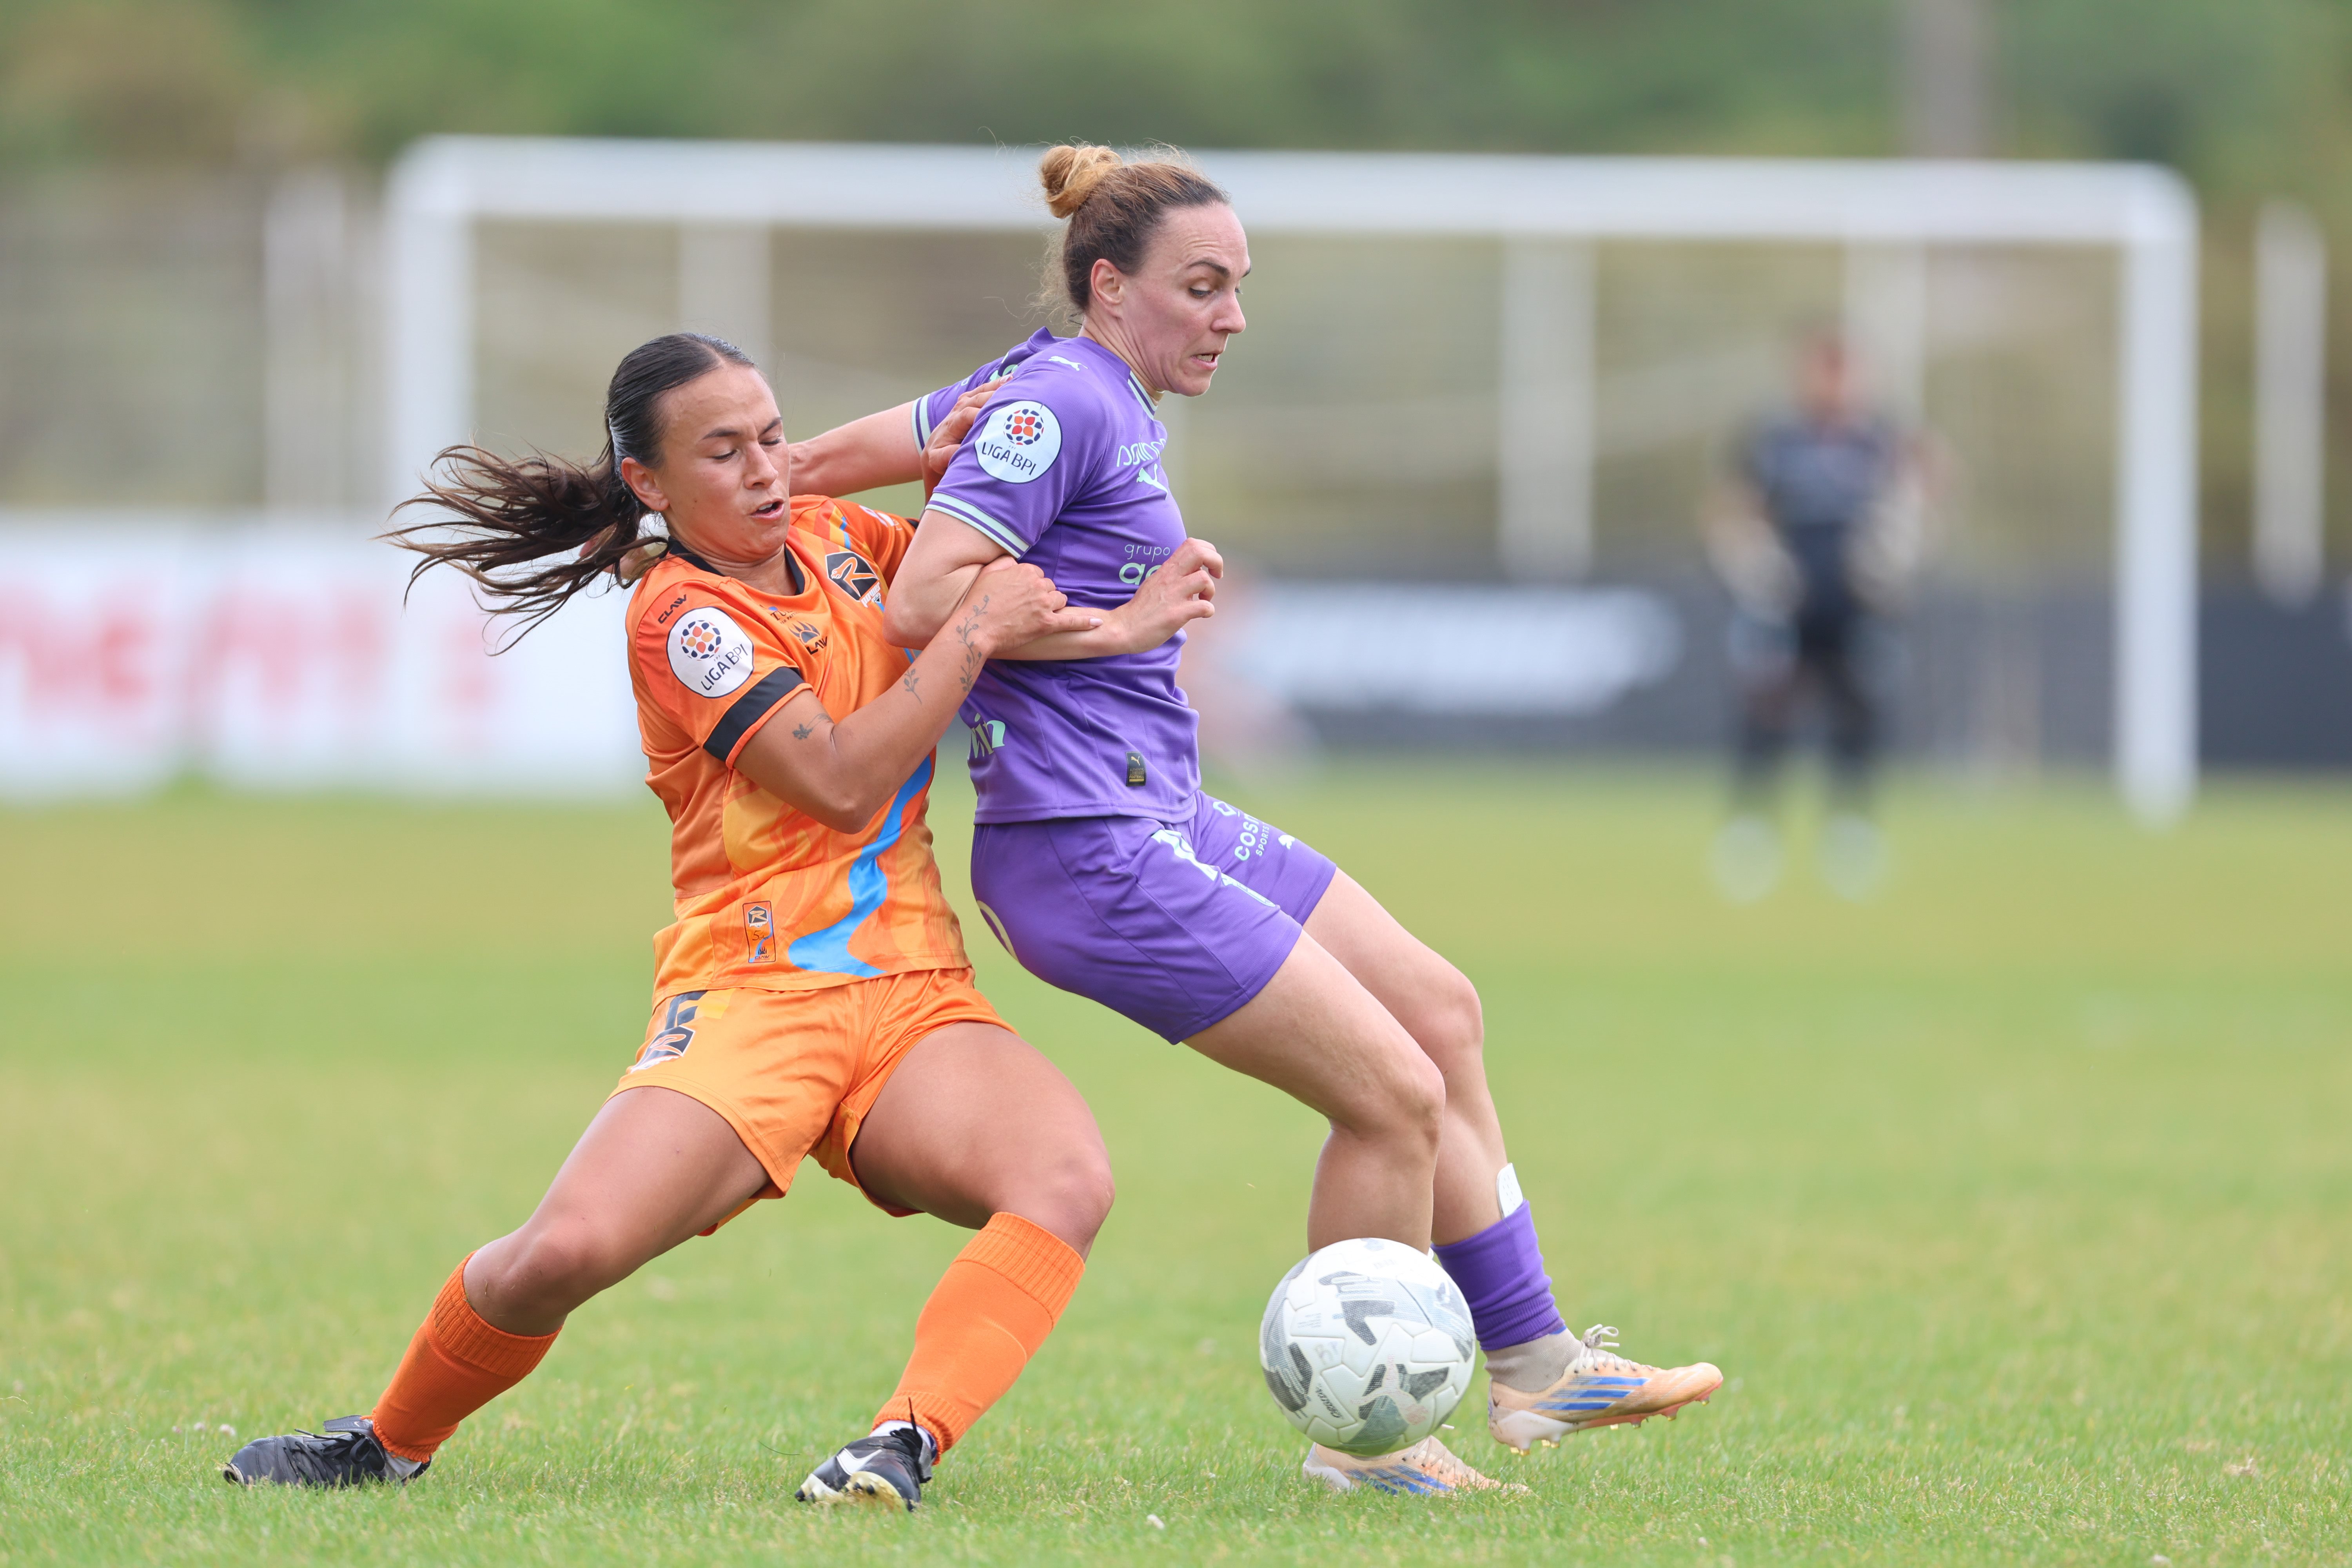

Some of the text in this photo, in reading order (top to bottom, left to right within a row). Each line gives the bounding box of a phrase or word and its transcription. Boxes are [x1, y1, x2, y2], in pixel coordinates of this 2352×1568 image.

[982, 442, 1036, 475] LIGA BPI
[1124, 544, 1170, 563] grupo
[658, 594, 686, 624] CLAW
[806, 636, 828, 655] LAW
[701, 644, 748, 691] LIGA BPI
[1256, 825, 1270, 857] SPORTS
